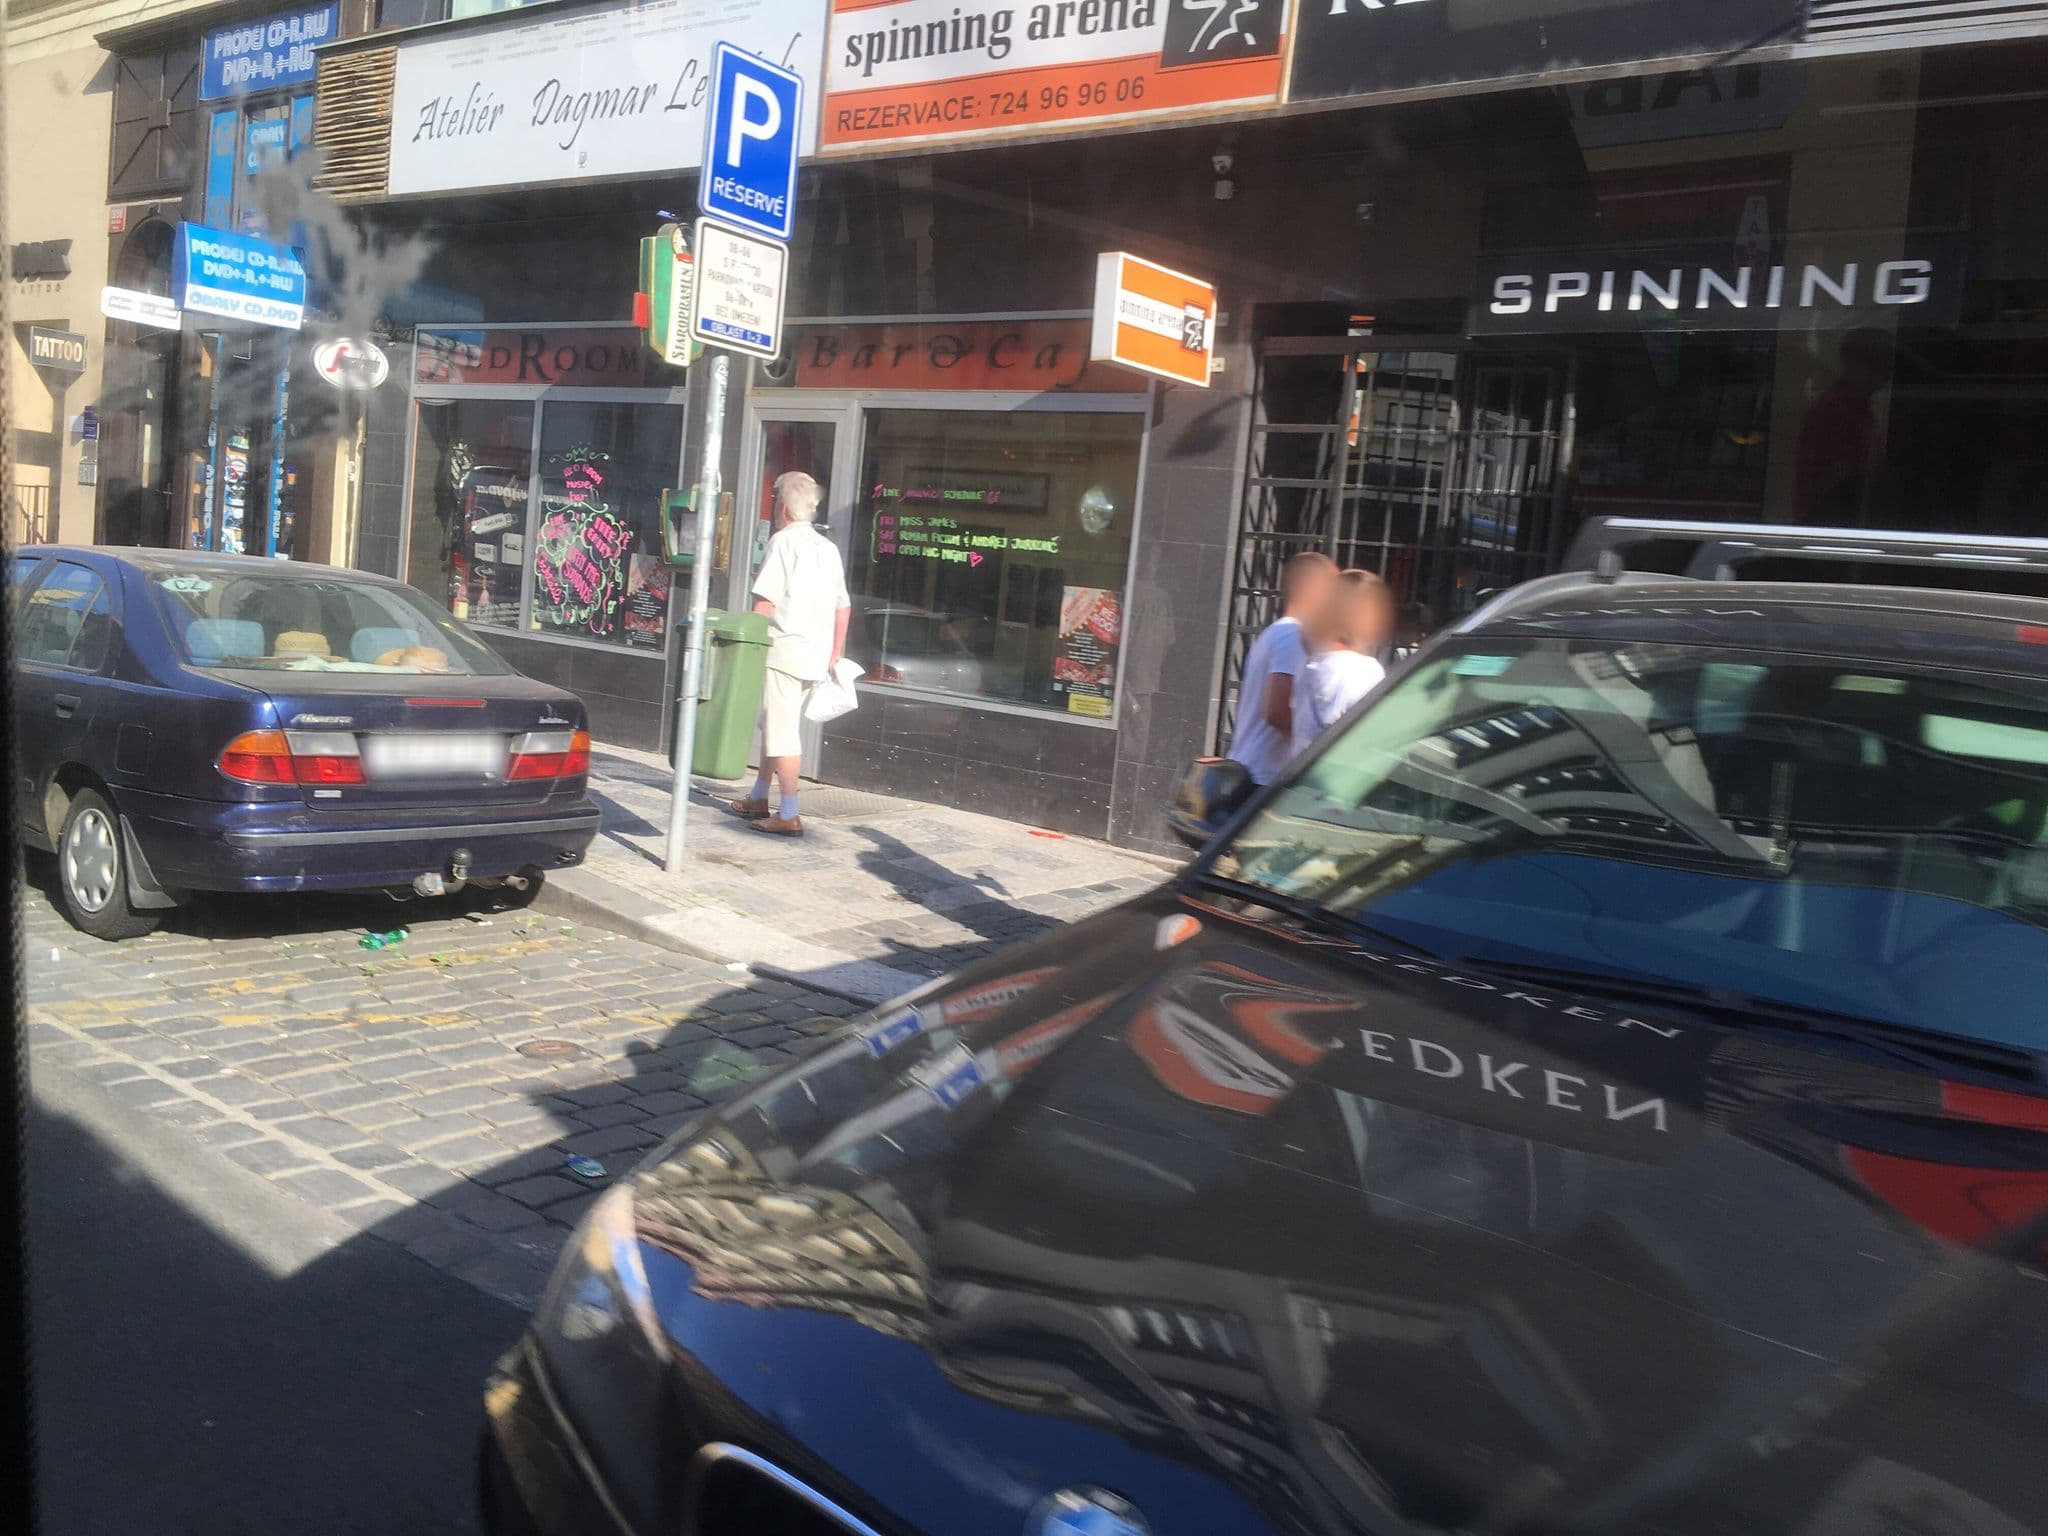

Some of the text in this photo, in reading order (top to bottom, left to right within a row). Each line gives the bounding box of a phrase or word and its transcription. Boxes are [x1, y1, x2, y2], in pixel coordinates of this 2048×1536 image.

[214, 25, 265, 59] PRODEJ
[845, 14, 1015, 76] spinning
[1027, 0, 1156, 42] arena
[413, 78, 657, 150] Ateliér Dagmar
[726, 72, 782, 168] P
[837, 75, 1146, 132] REZERVACE: 724 96 96 06
[713, 176, 785, 219] RÉSERVÉ
[191, 239, 244, 263] PRODEJ
[1490, 259, 1934, 315] SPINNING
[34, 336, 83, 363] TATTOO
[519, 334, 640, 382] ROOM
[810, 334, 912, 370] Bar
[174, 579, 203, 591] CZ
